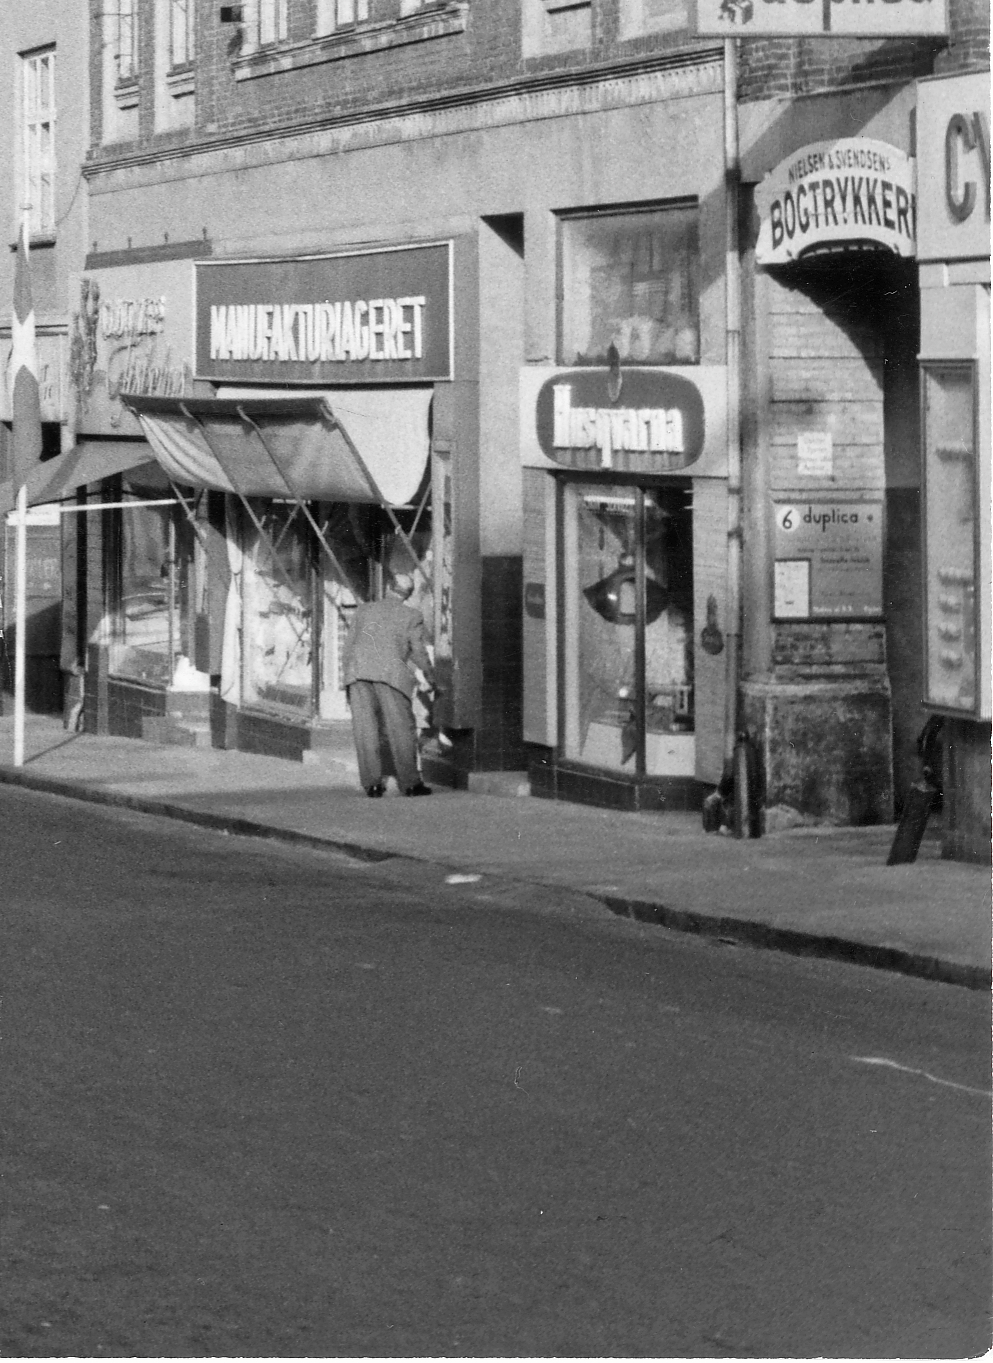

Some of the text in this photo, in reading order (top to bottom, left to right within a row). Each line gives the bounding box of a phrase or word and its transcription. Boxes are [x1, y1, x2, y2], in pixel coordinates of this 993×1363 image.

[787, 152, 826, 184] NIELSEN
[210, 295, 426, 363] MANUFAKTURLAGERET
[782, 506, 859, 533] 6 duplica
